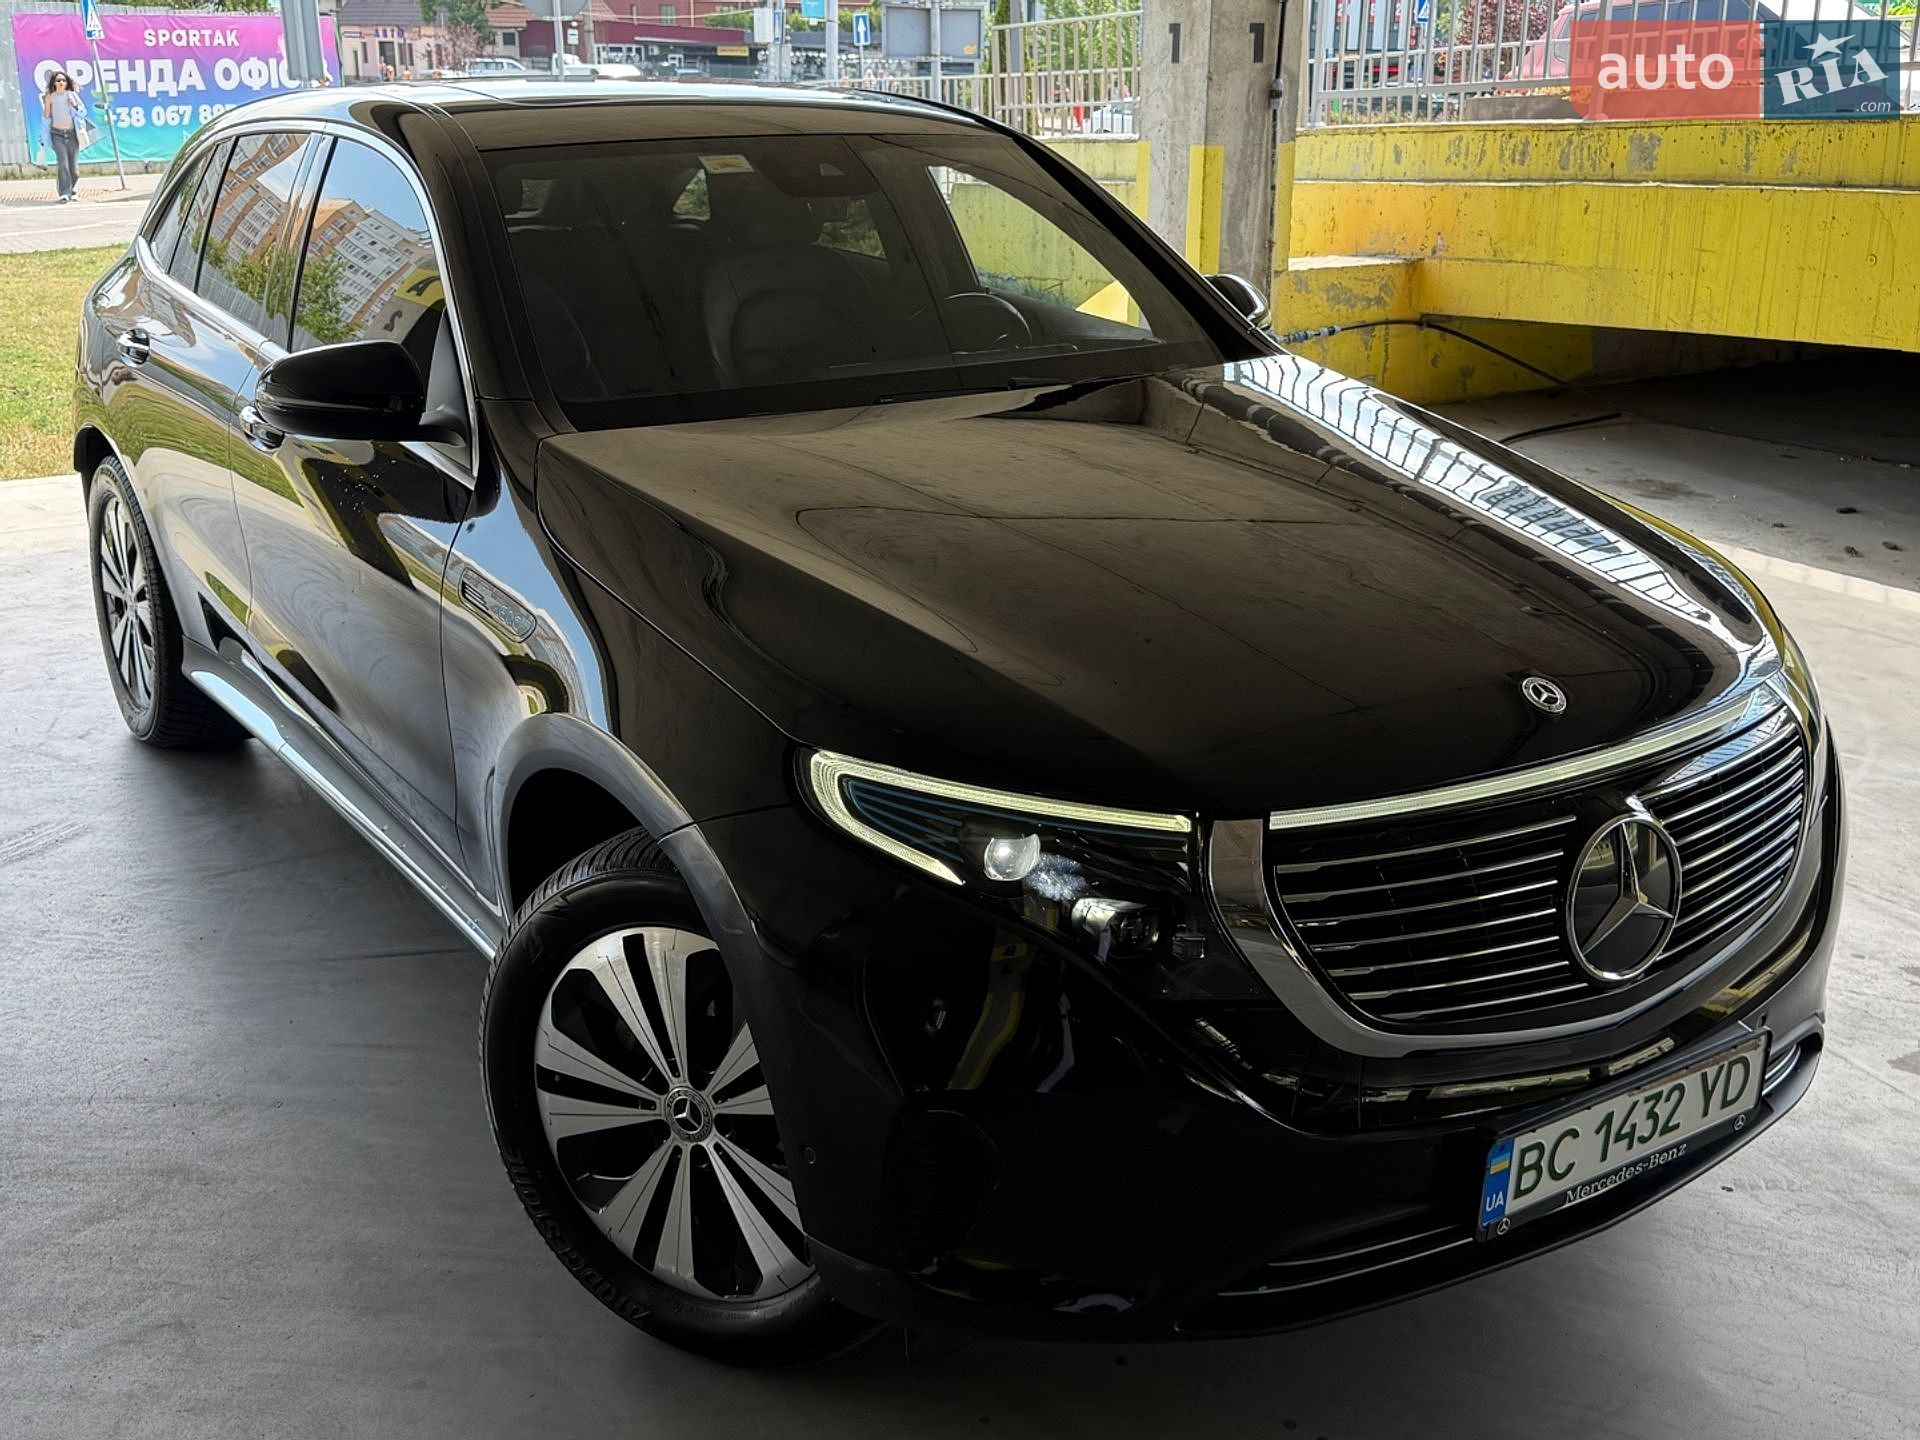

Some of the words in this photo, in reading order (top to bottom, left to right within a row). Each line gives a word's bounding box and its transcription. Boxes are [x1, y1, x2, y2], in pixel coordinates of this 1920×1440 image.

[1169, 23, 1181, 63] 1
[1249, 23, 1265, 63] 1
[34, 58, 206, 97] ОРЕНДА
[151, 104, 193, 127] 067
[1513, 1128, 1580, 1200] BC
[1595, 1082, 1686, 1163] 1432
[1700, 1055, 1751, 1118] YD
[1564, 1143, 1687, 1205] Mercedes-Benz
[1485, 1190, 1505, 1213] UA
